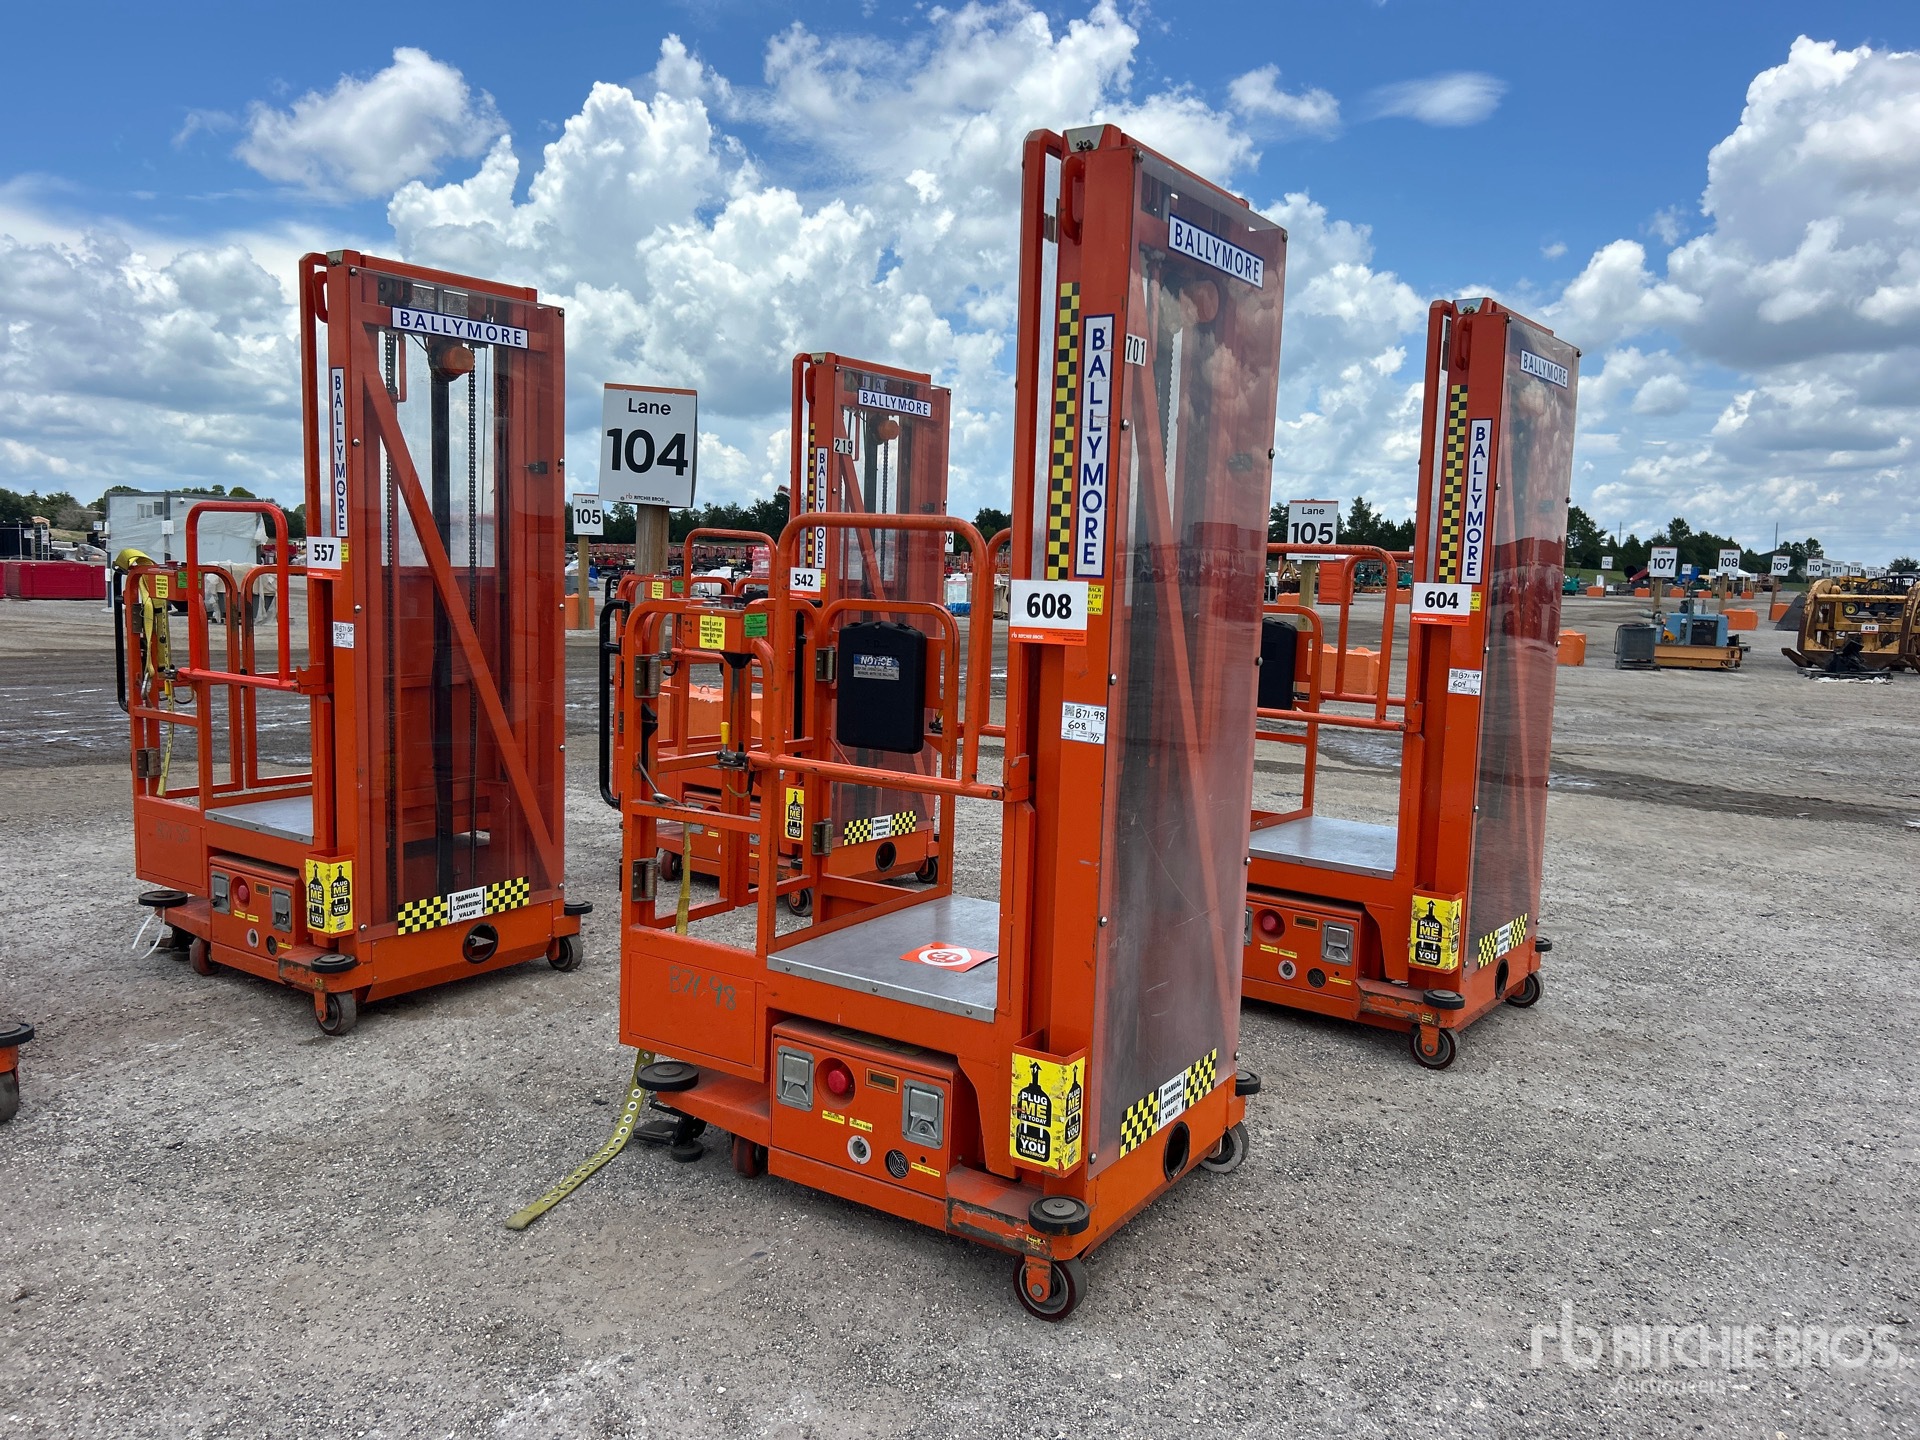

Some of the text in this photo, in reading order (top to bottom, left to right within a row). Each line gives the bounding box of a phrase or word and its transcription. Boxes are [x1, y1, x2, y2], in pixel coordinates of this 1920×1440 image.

[1174, 222, 1260, 283] BALLYMORE
[400, 310, 523, 346] BALLYMORE
[1126, 336, 1146, 365] 701
[1523, 353, 1567, 385] BALLYMORE
[628, 397, 672, 416] Lane
[862, 392, 928, 415] BALLYMORE
[334, 375, 346, 531] BALLYMORE
[606, 428, 689, 476] 104
[834, 438, 853, 454] 219
[1082, 328, 1106, 565] BALLYMORE
[816, 452, 826, 564] BALLYORE
[1466, 426, 1486, 577] BALLYMORE
[575, 508, 601, 525] 105
[1301, 506, 1325, 515] Lane
[1290, 522, 1334, 545] 105
[314, 543, 335, 562] 557
[1652, 558, 1675, 570] 107
[1720, 557, 1738, 567] 108
[1772, 562, 1789, 571] 109
[1808, 564, 1821, 572] 110
[794, 573, 814, 587] 542
[1026, 592, 1072, 620] 608
[1424, 591, 1459, 609] 604
[860, 655, 893, 667] NOTICE
[1452, 679, 1467, 688] 604
[1067, 719, 1087, 731] 608
[310, 883, 323, 892] PLUG
[332, 880, 348, 888] PLUG
[333, 885, 348, 896] ME
[310, 889, 323, 901] ME
[455, 891, 480, 903] MANUAL
[333, 904, 349, 913] YOU
[452, 899, 482, 911] LOWERING
[310, 914, 323, 925] YOU
[458, 909, 477, 919] VALVE
[1419, 925, 1439, 937] ME
[1420, 920, 1440, 929] PLUG
[1418, 950, 1438, 961] YOU
[1068, 1088, 1081, 1100] PLUG
[1163, 1079, 1182, 1097] MANUAL
[1021, 1091, 1048, 1106] PLUG
[1068, 1094, 1080, 1111] ME
[1161, 1090, 1183, 1111] LOWERING
[1021, 1100, 1047, 1120] ME
[1027, 1114, 1047, 1125] TODAY
[1067, 1124, 1080, 1138] YOU
[1020, 1138, 1046, 1155] YOU
